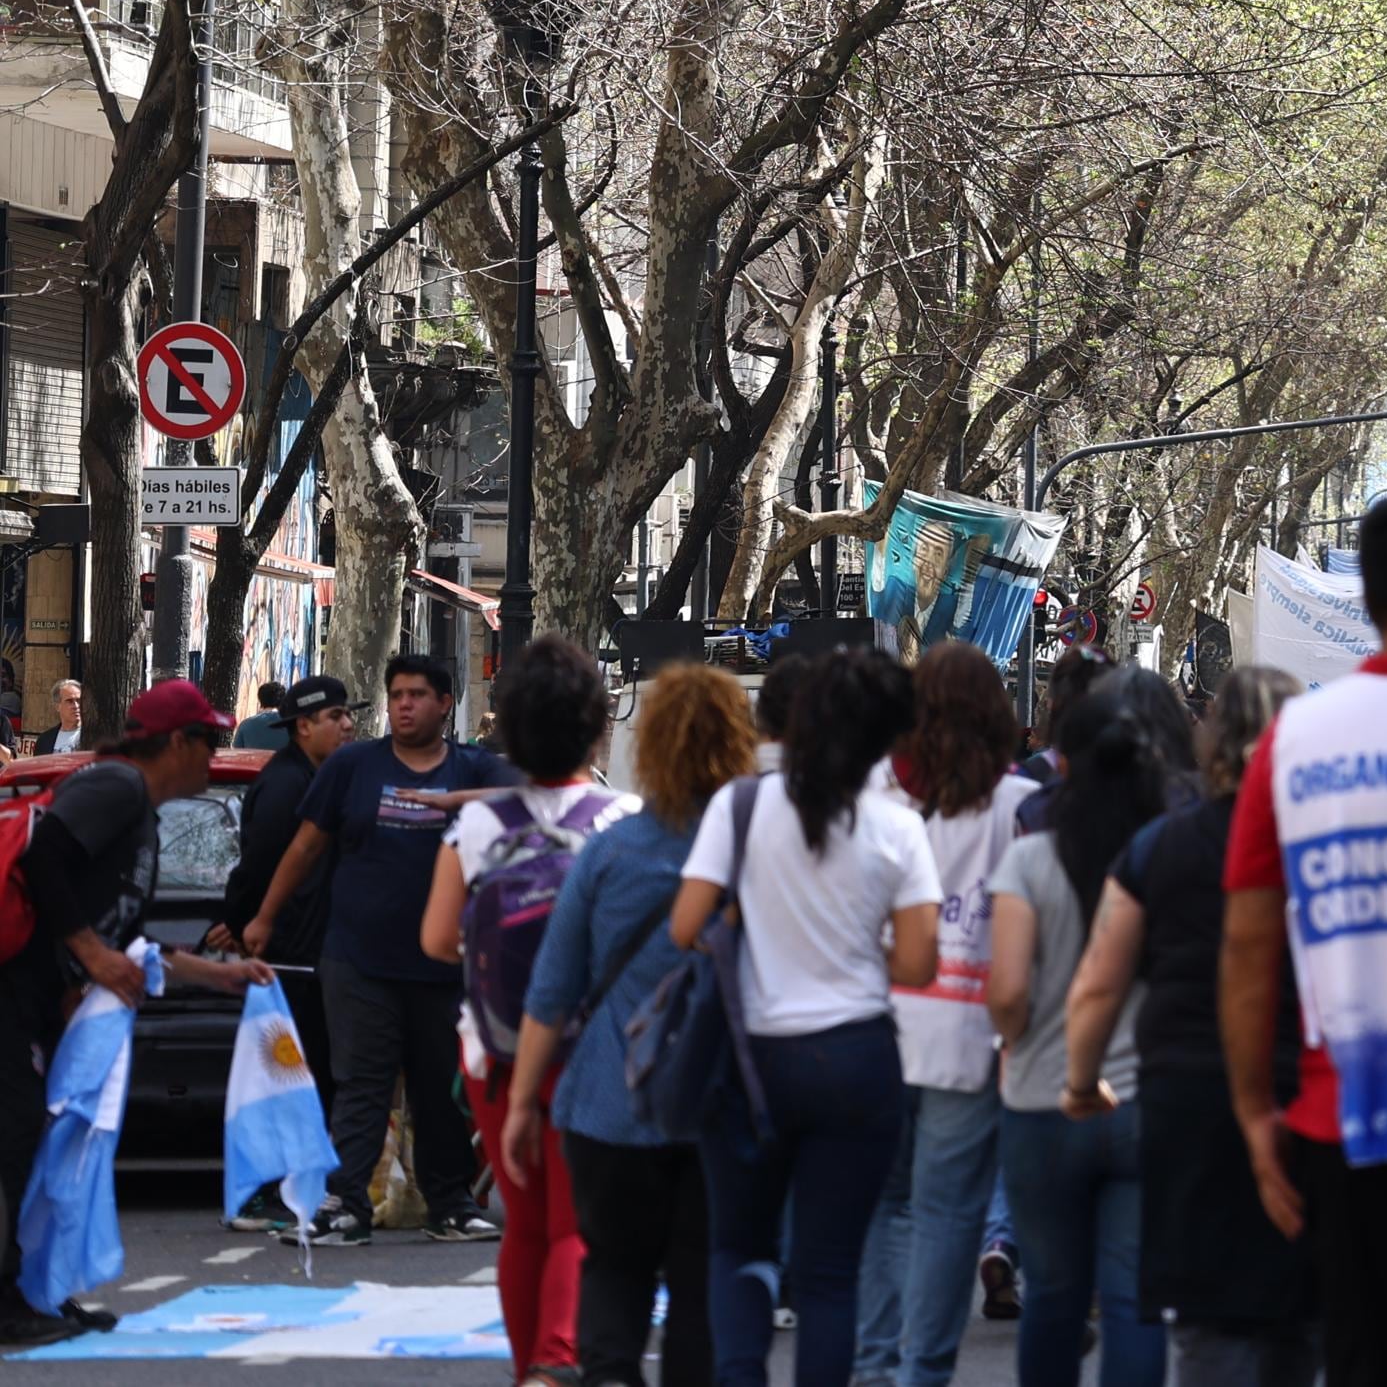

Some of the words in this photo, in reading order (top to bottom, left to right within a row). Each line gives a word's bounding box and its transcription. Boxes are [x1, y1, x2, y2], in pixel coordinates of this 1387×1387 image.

[175, 480, 230, 493] hábiles
[142, 500, 153, 513] e
[159, 500, 167, 513] 7
[172, 503, 180, 513] a
[186, 500, 202, 513] 21
[208, 500, 231, 513] hs.
